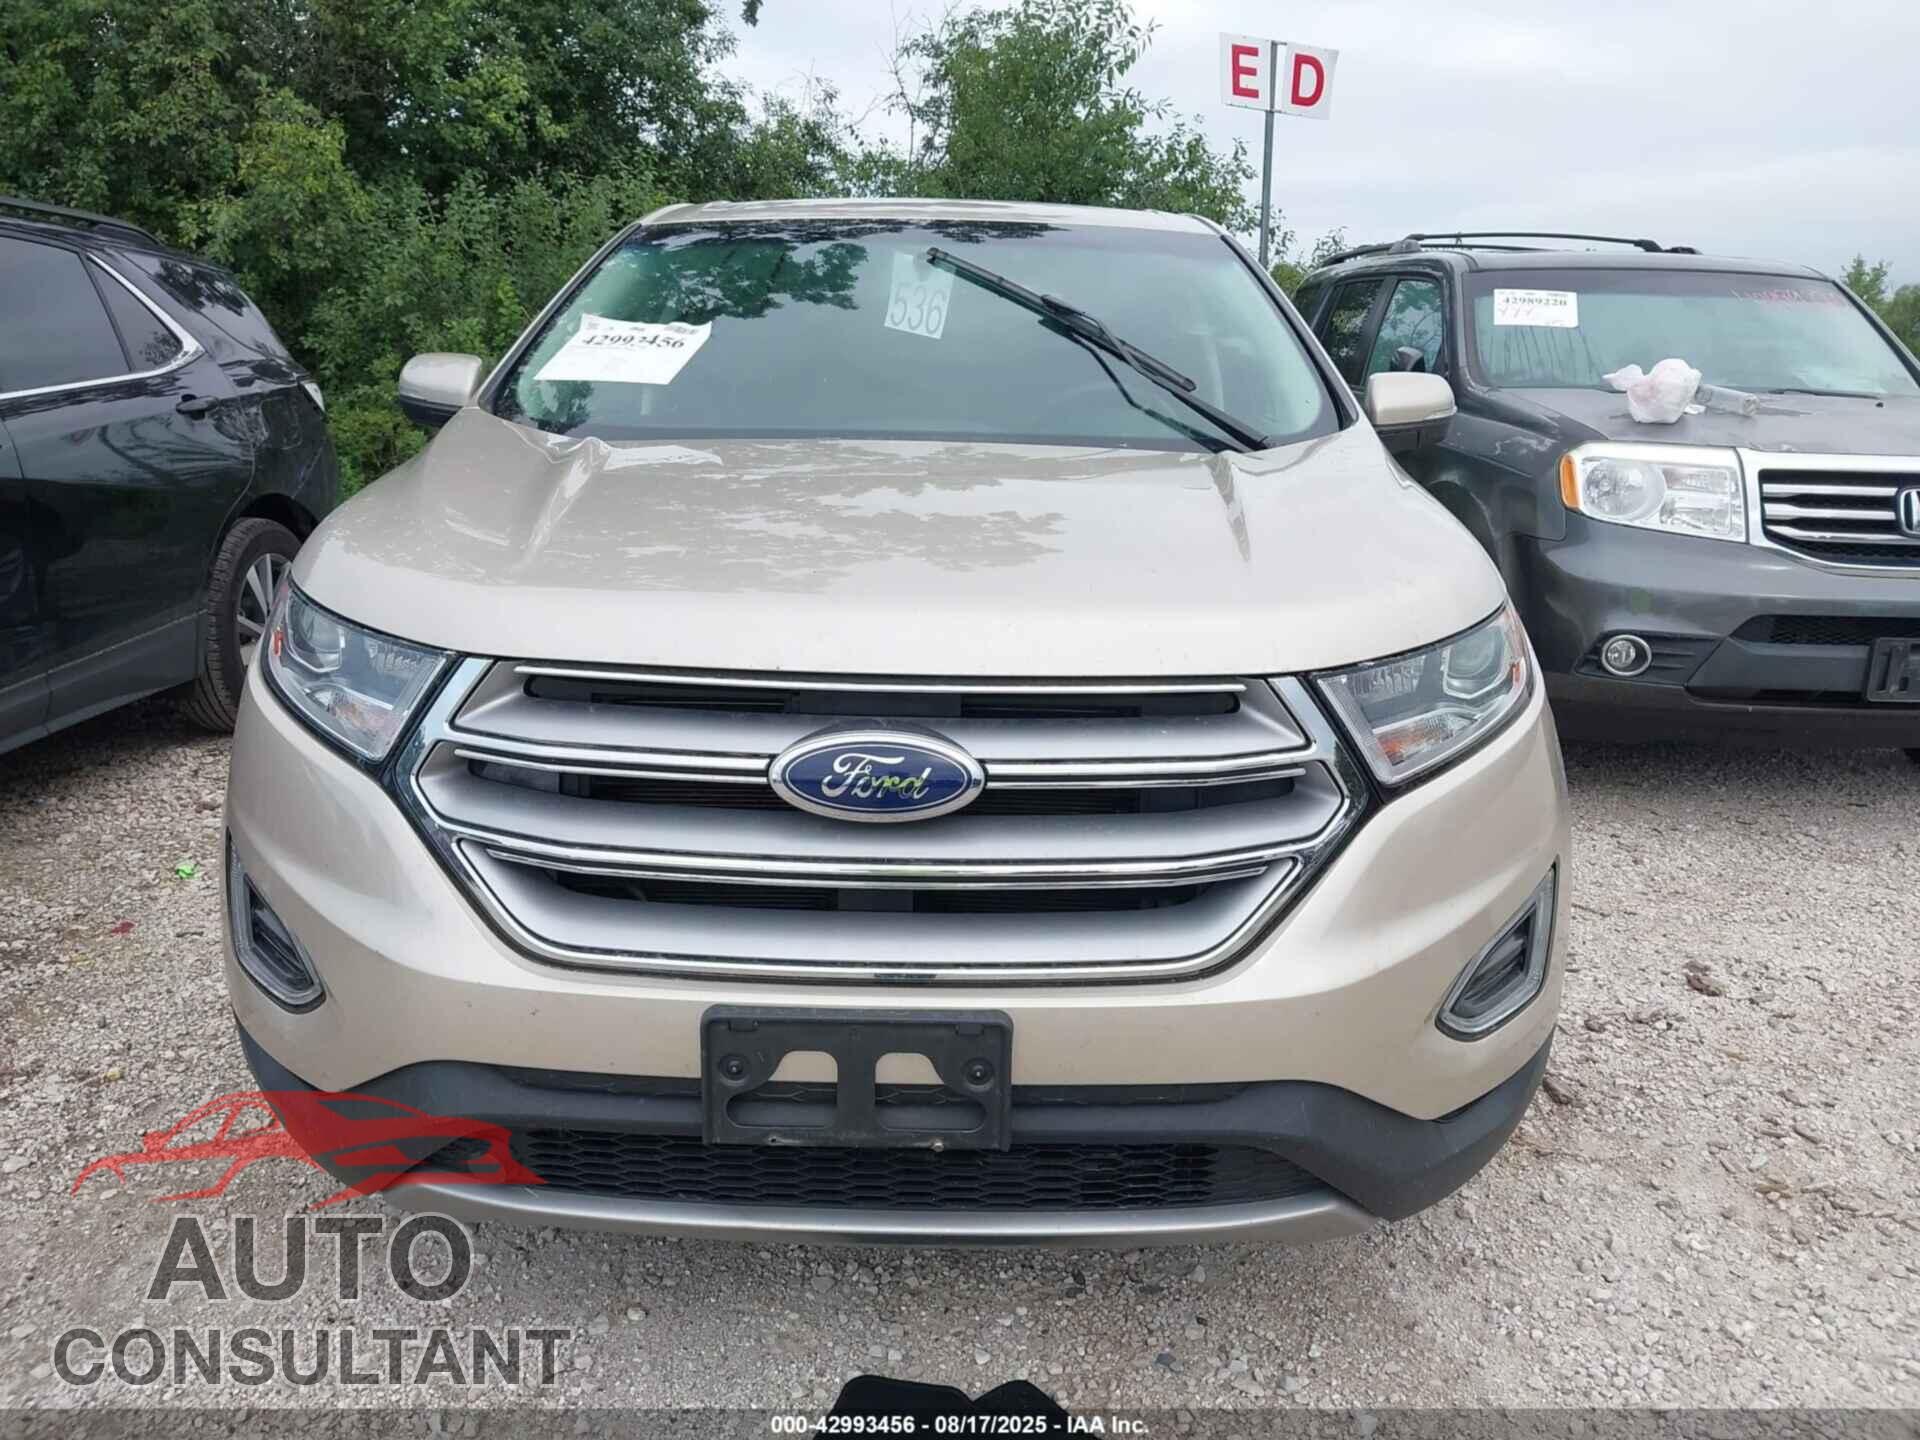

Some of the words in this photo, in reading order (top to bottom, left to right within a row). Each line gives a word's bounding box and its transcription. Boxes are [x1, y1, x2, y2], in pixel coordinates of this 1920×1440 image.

[1231, 43, 1259, 99] E
[1291, 53, 1325, 107] D
[890, 283, 945, 334] 536
[821, 752, 933, 801] Ford
